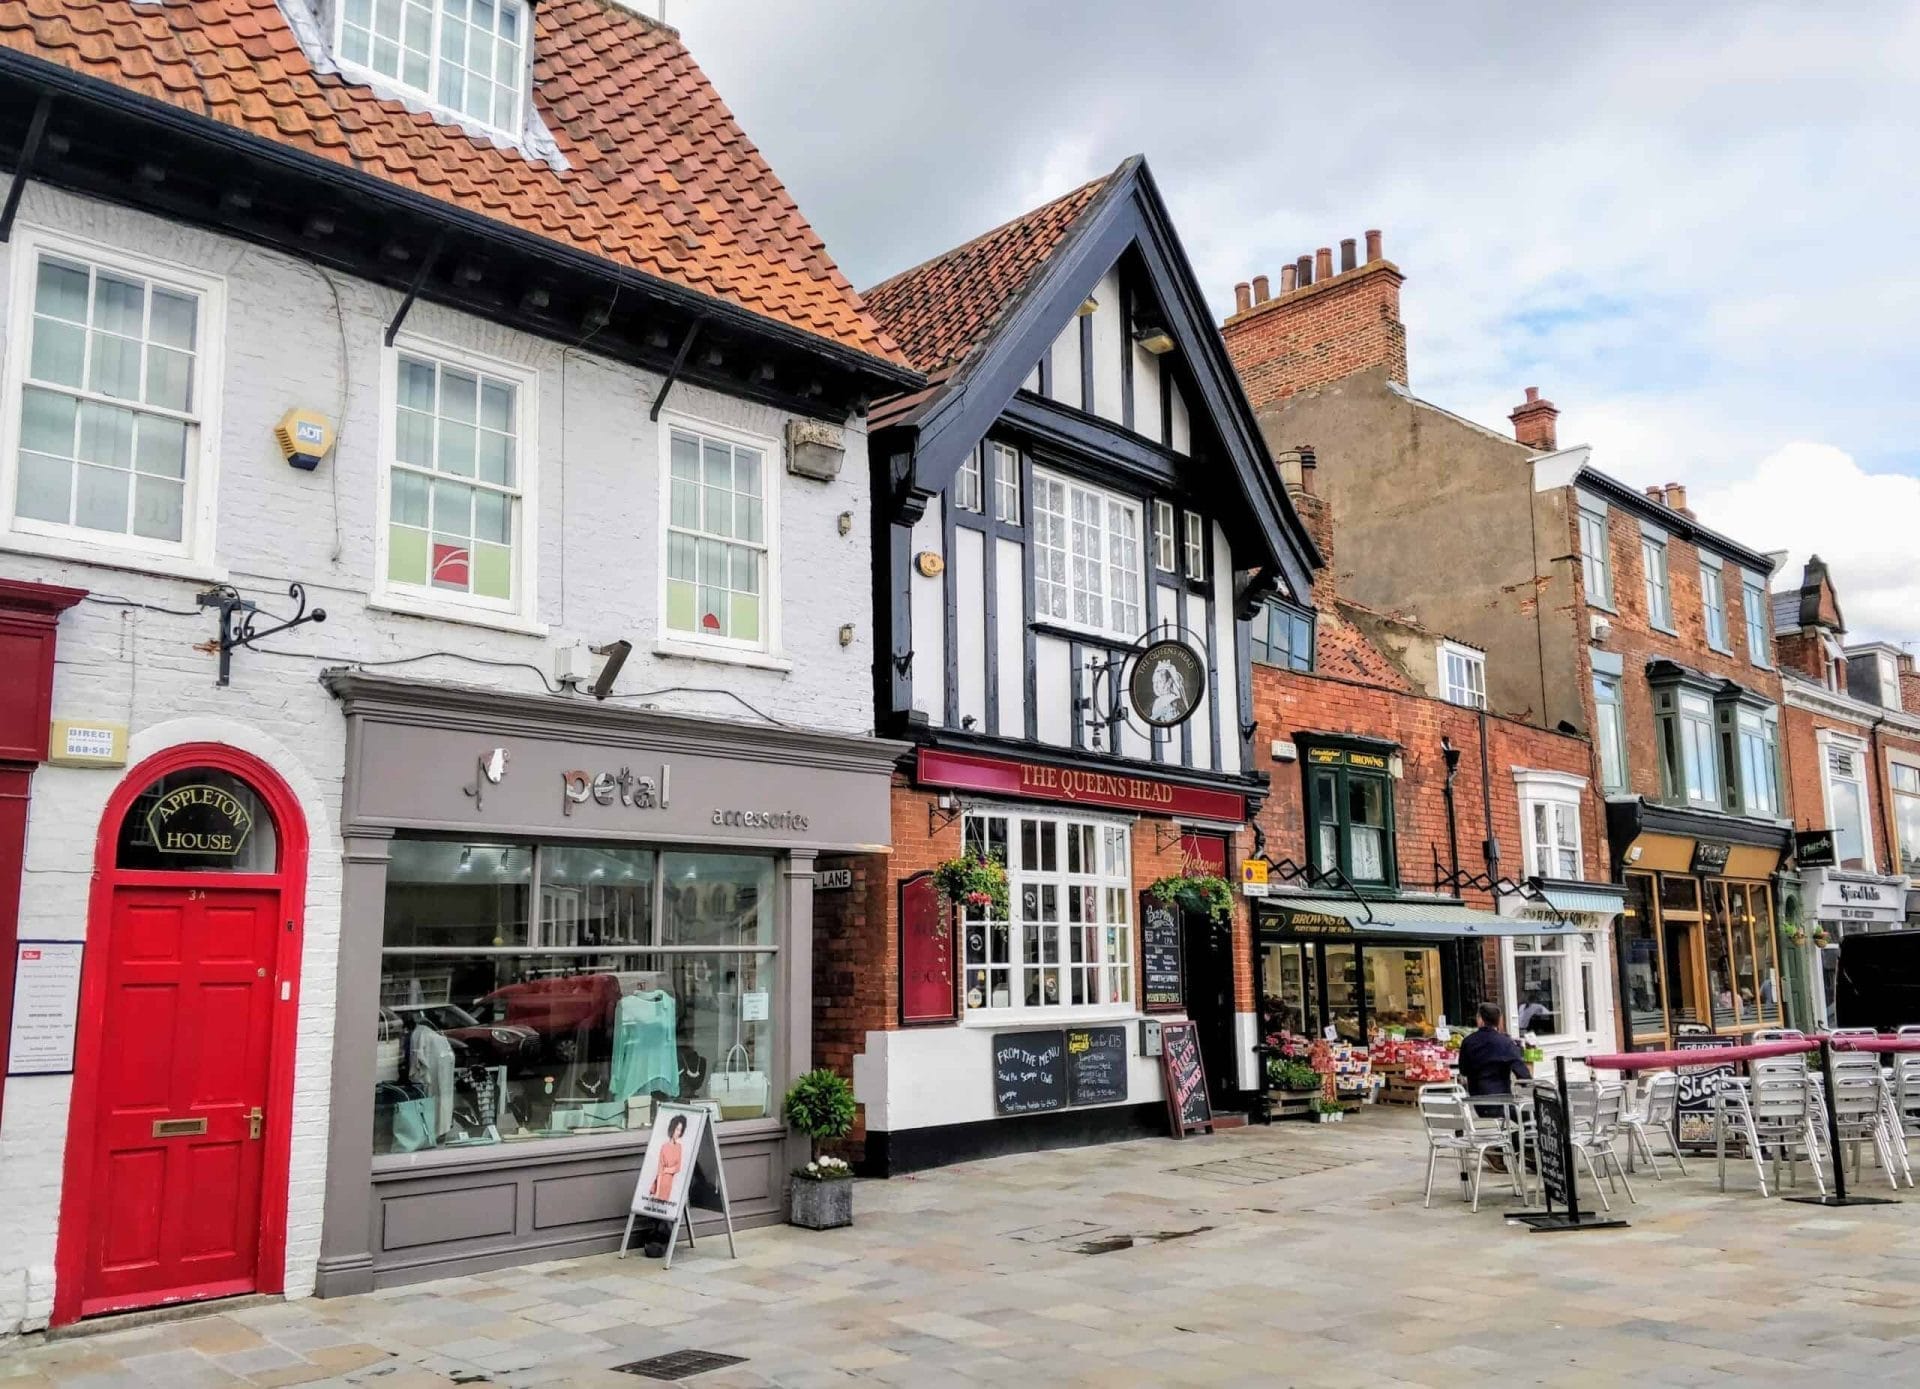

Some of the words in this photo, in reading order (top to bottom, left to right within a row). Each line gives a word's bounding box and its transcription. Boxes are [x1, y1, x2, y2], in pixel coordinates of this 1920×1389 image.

[298, 425, 323, 441] ADT
[1139, 660, 1151, 674] THE
[1149, 647, 1178, 661] QUEENS
[1178, 652, 1195, 669] HEAD
[69, 729, 111, 739] DIRECT
[1350, 753, 1384, 768] BROWNS
[563, 764, 671, 816] petal
[1020, 764, 1058, 789] THE
[1060, 769, 1128, 799] QUEENS
[1129, 779, 1173, 803] HEAD
[159, 789, 247, 828] APPLETON
[712, 807, 811, 842] accessories
[166, 832, 233, 850] HOUSE
[822, 871, 849, 887] LANE
[1292, 912, 1336, 926] BROWNS
[997, 1047, 1020, 1065] FROM
[1021, 1049, 1037, 1067] THE
[1038, 1046, 1060, 1067] MENU
